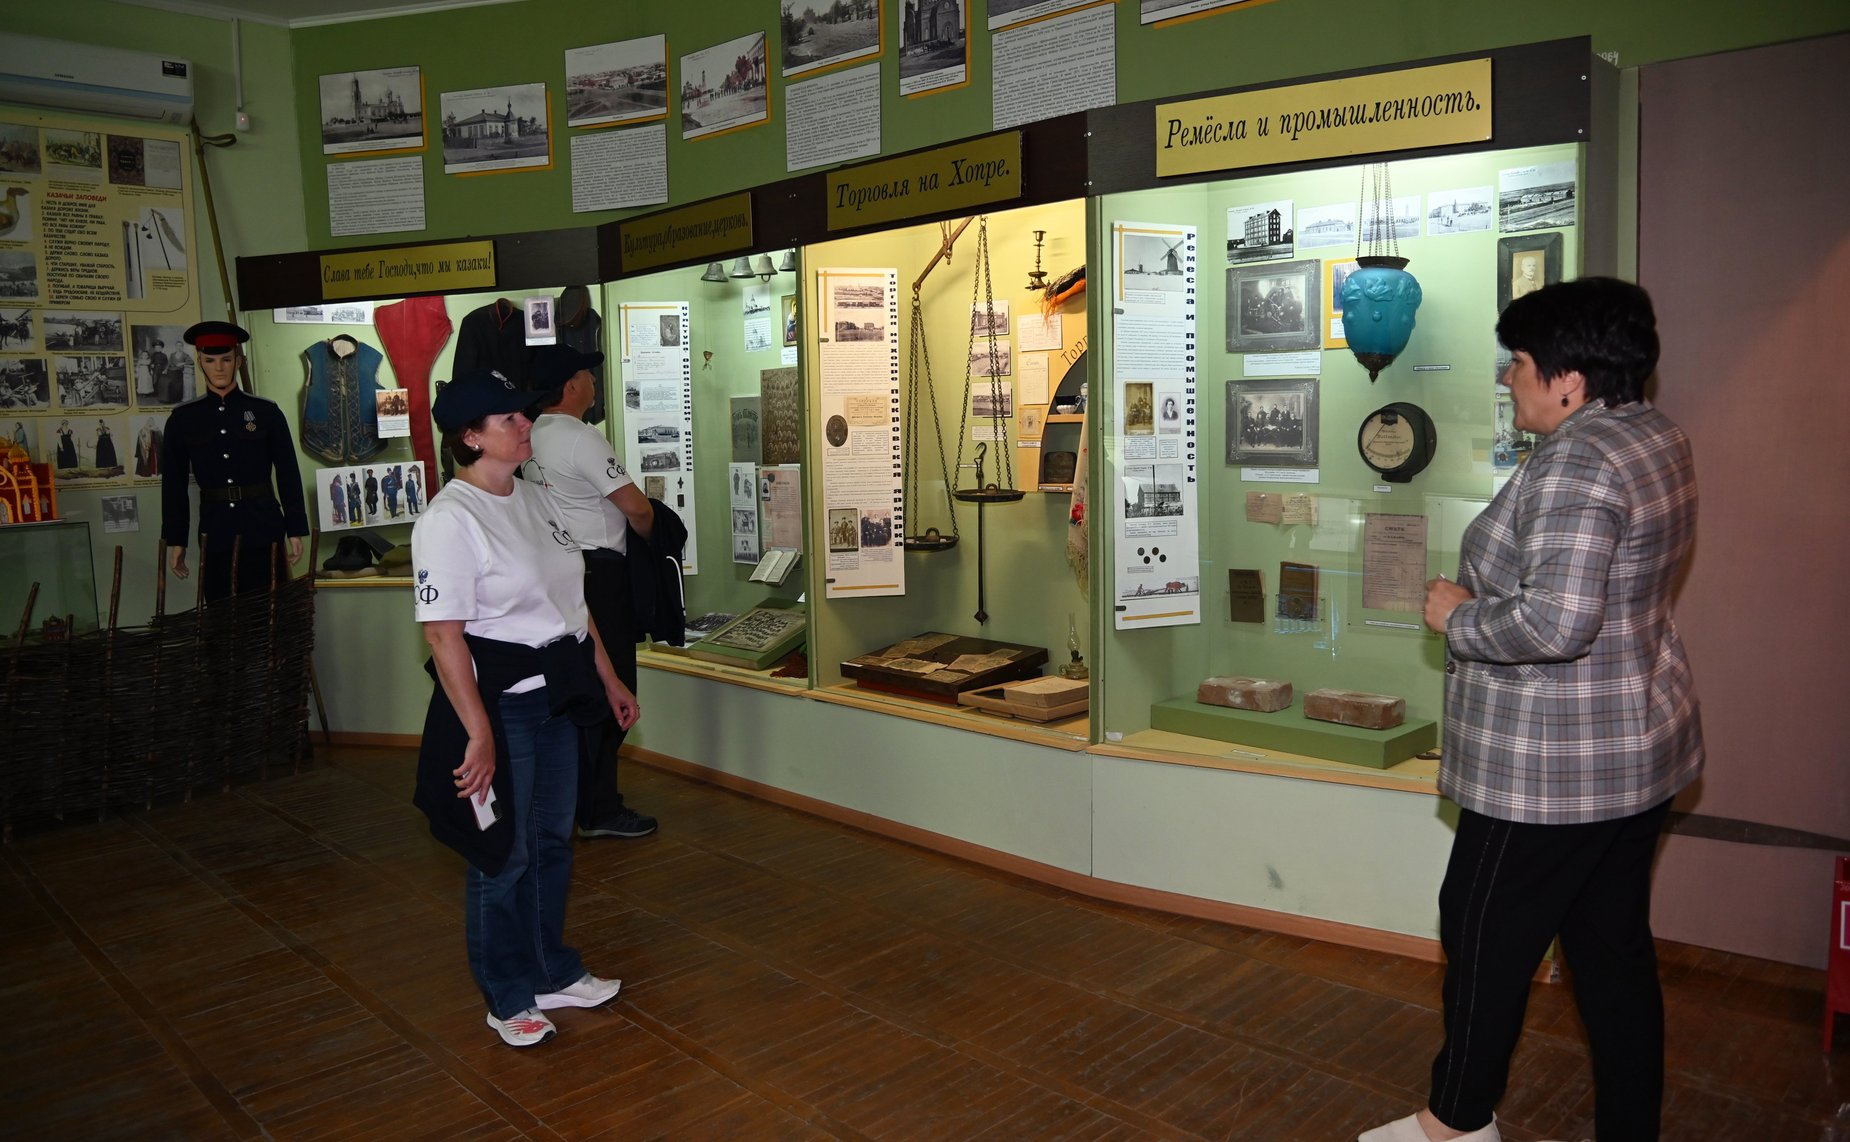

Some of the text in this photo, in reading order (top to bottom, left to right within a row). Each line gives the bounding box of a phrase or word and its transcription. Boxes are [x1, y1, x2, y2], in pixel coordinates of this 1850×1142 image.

[1164, 89, 1481, 149] Ремёсла и промышленность.
[75, 194, 107, 202] ЗАПОВЕДИ
[836, 158, 1010, 211] Торговля на Хопре.
[324, 265, 350, 284] Слава
[354, 262, 375, 279] тебе
[438, 261, 451, 273] мы
[456, 251, 492, 271] казаки!
[1186, 233, 1195, 305] Ремесла
[1186, 332, 1196, 483] промышленность
